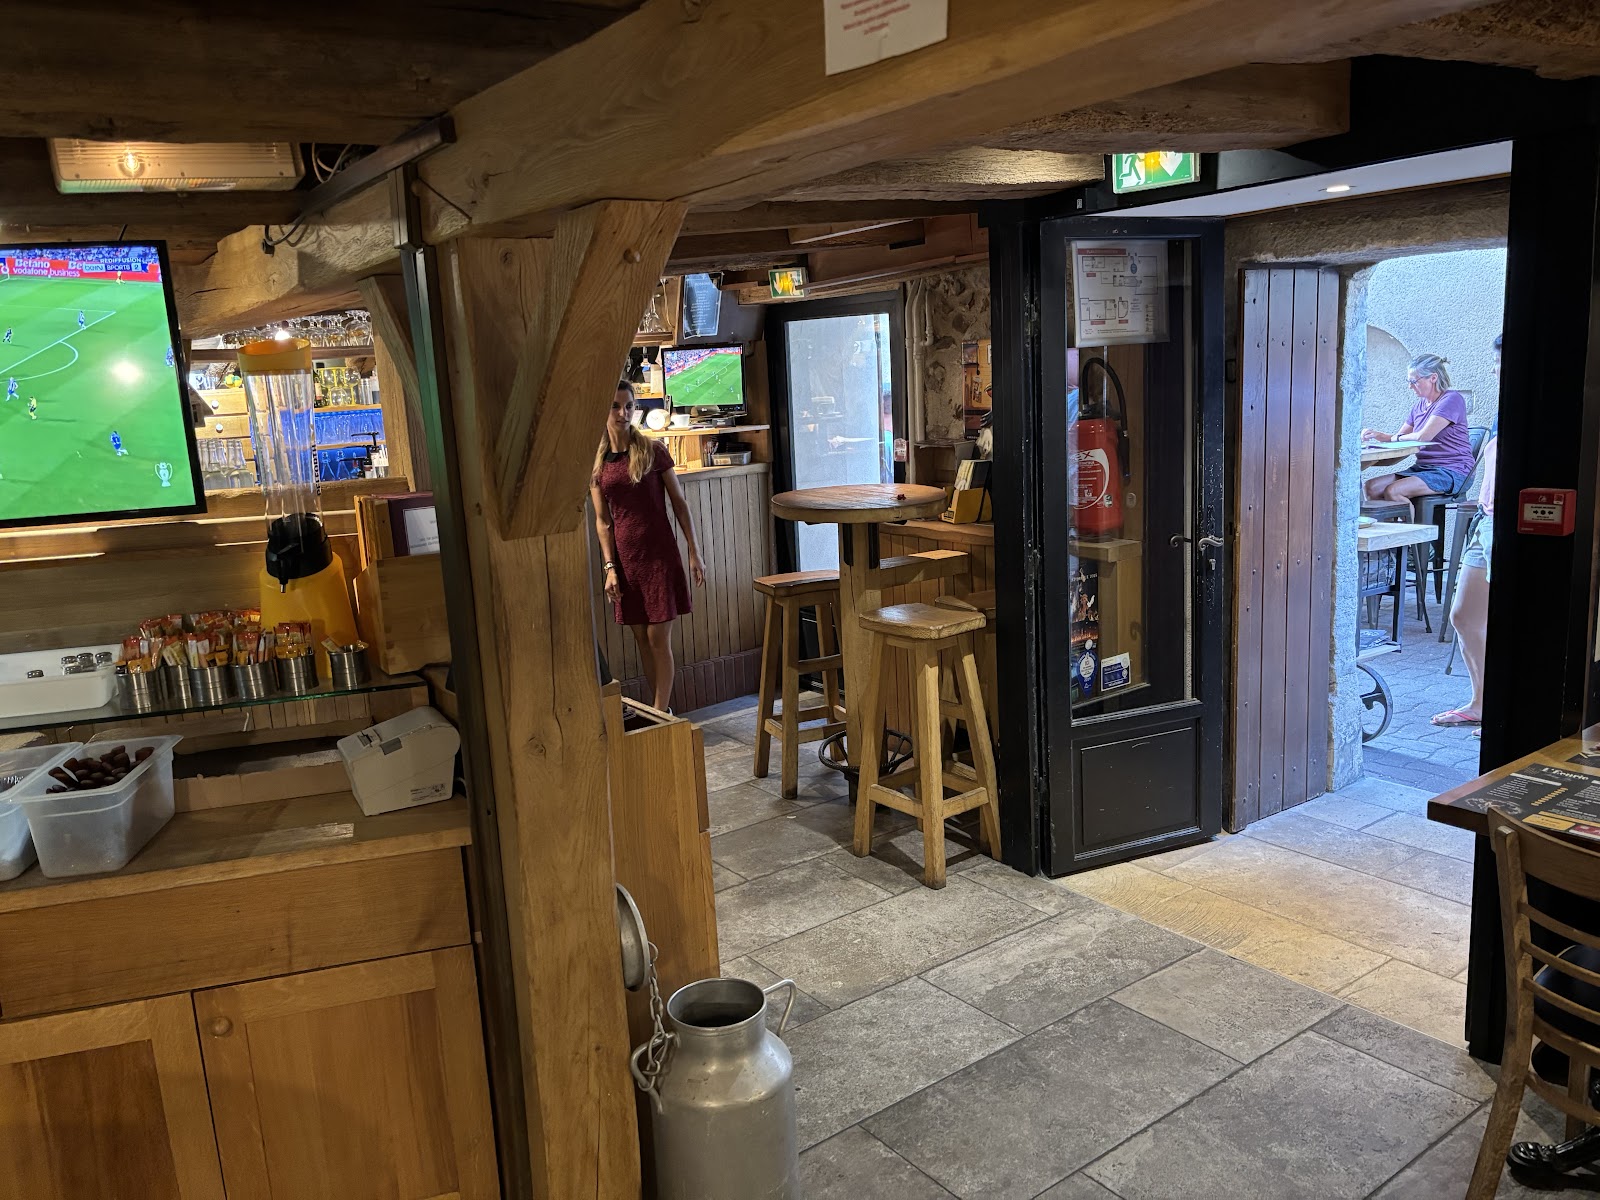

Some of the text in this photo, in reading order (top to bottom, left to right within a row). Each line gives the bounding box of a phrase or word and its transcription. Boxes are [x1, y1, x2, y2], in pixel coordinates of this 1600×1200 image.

[15, 258, 50, 269] Betano
[13, 267, 80, 277] vodafone business
